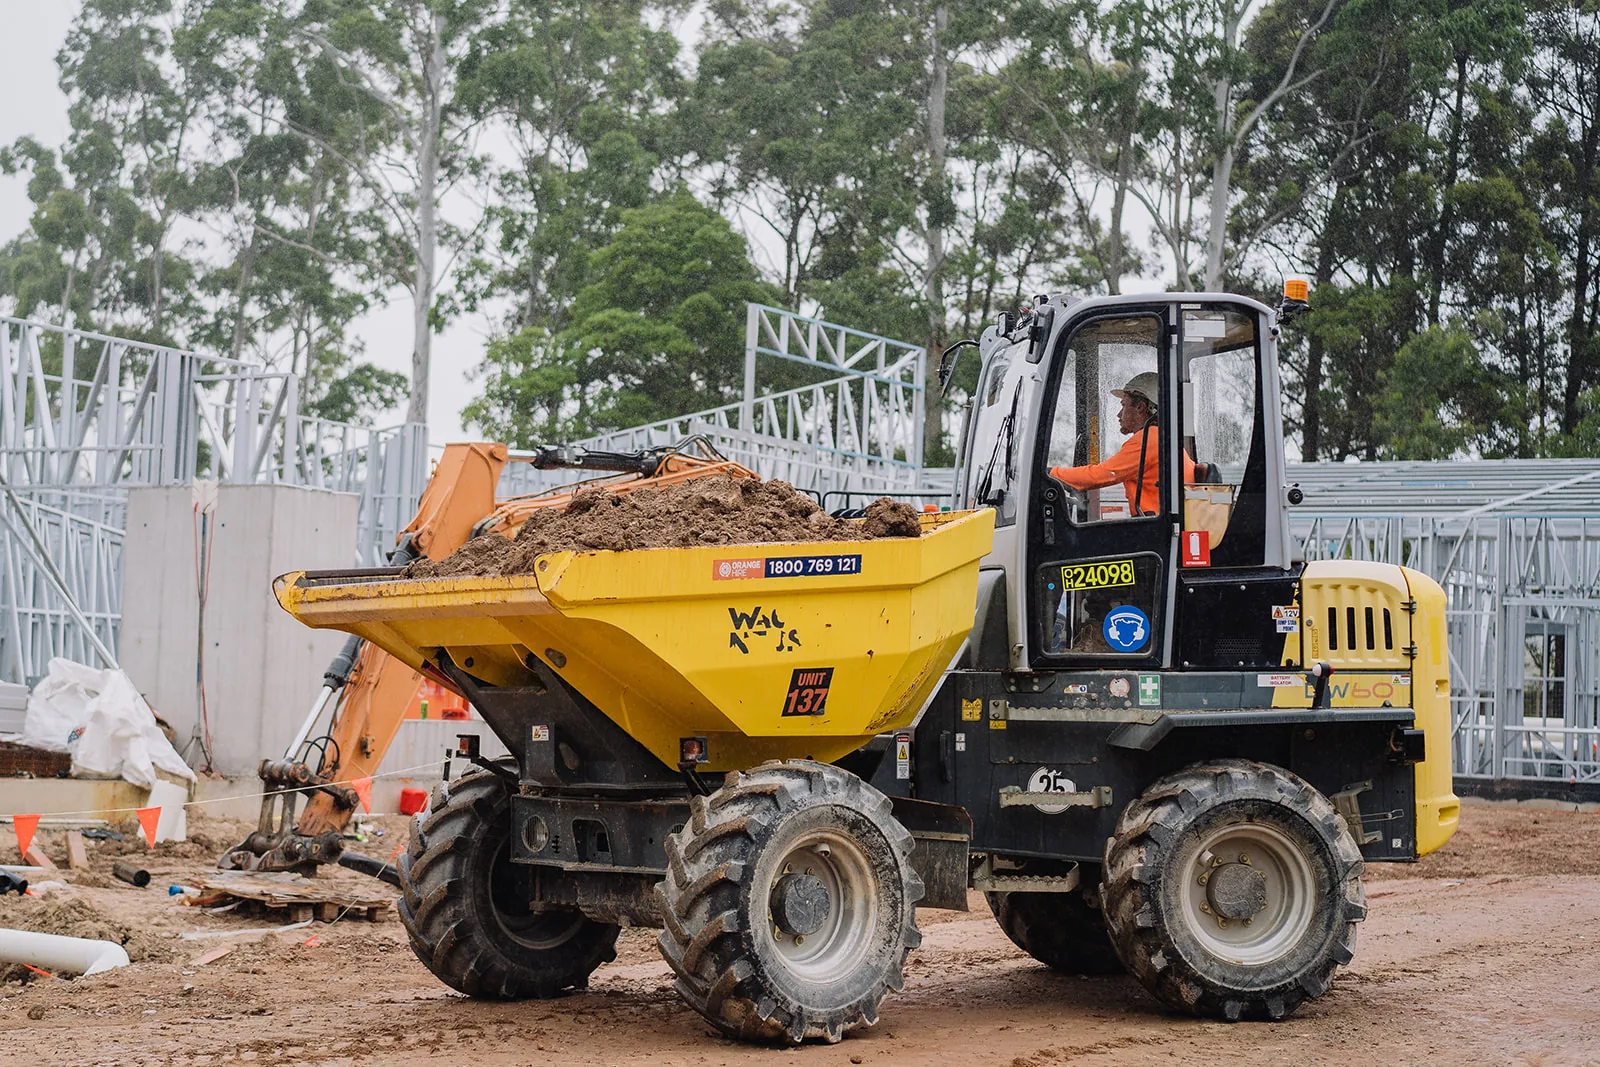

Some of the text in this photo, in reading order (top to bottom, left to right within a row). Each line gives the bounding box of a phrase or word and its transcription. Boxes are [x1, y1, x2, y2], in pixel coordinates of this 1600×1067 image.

[731, 568, 747, 577] HIRE
[732, 560, 761, 570] ORANGE
[769, 557, 856, 575] 1800 769 121
[1073, 563, 1133, 588] 24098
[797, 672, 827, 686] UNIT
[787, 687, 828, 714] 137
